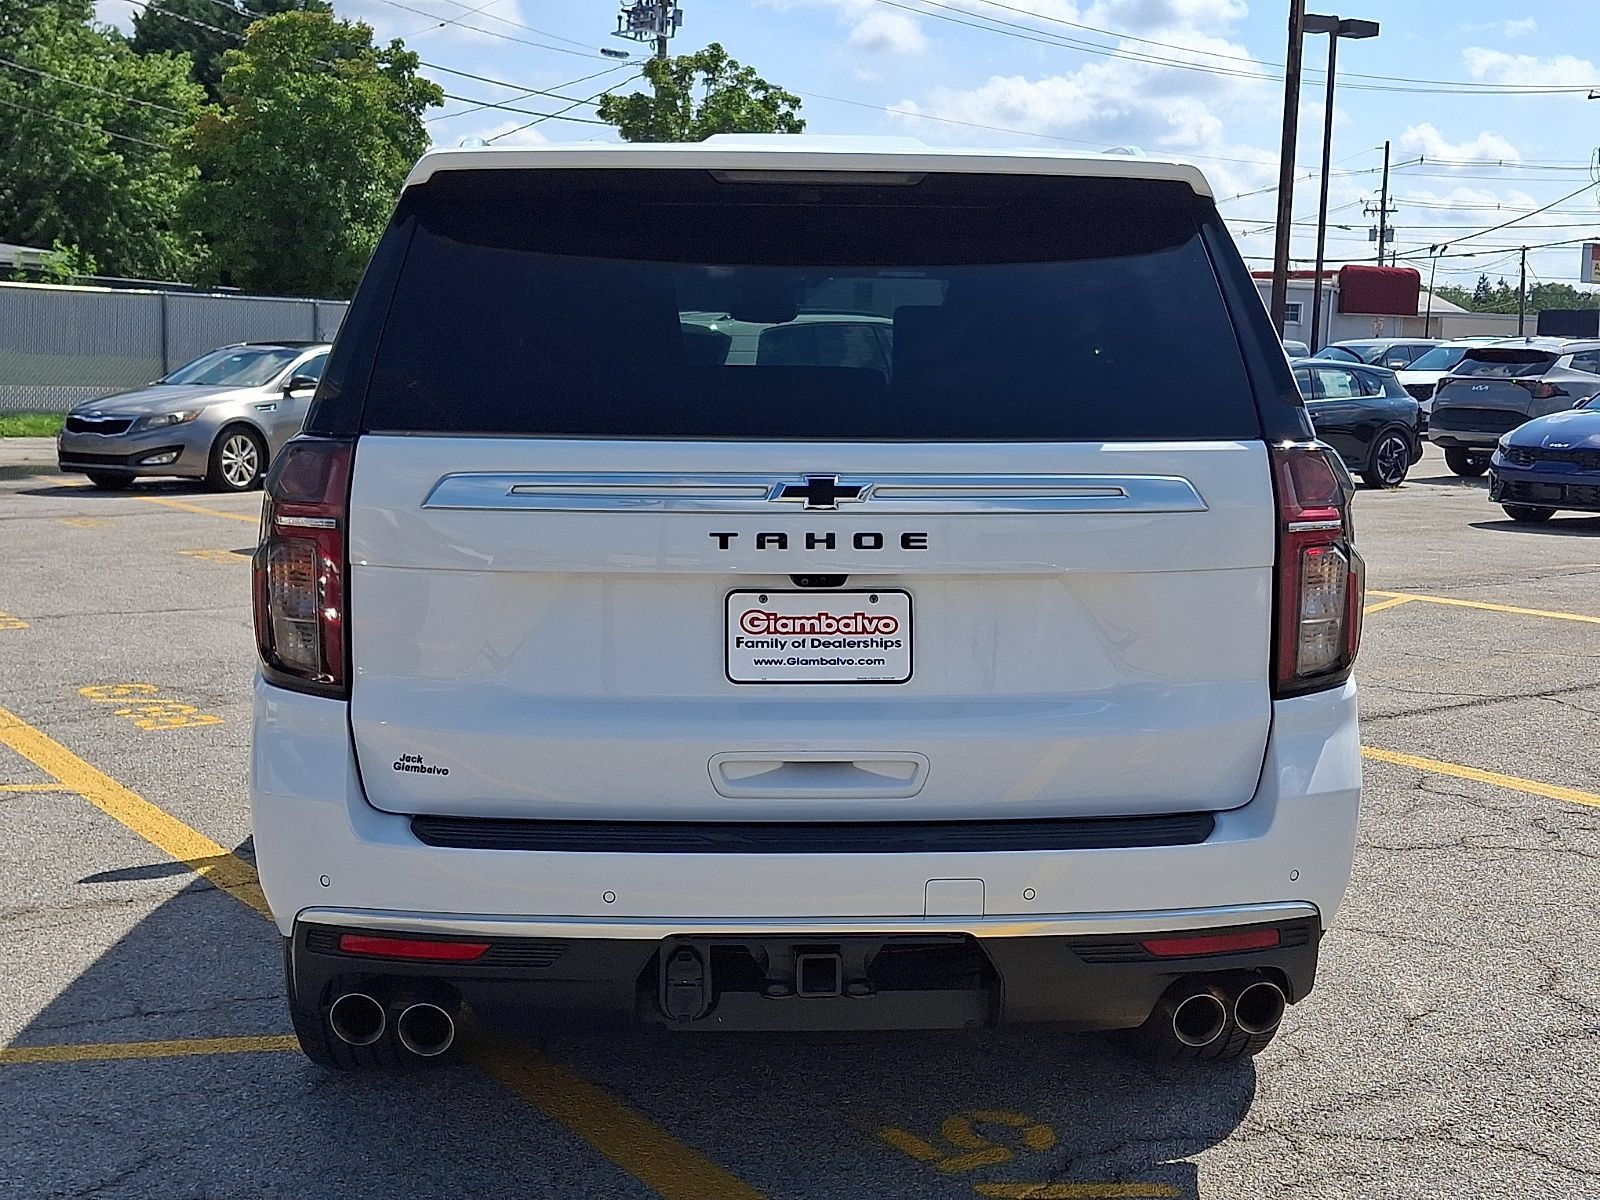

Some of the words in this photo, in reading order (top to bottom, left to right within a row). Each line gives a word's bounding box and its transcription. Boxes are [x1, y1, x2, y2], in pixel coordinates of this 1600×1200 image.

[709, 532, 928, 550] TAHOE
[739, 609, 899, 635] Giambalvo
[736, 636, 788, 651] Family
[791, 637, 807, 649] of
[810, 637, 902, 651] Dealerships
[753, 657, 885, 666] www.Giambalvo.com
[399, 753, 424, 764] Jack
[393, 761, 449, 776] Giambalvo
